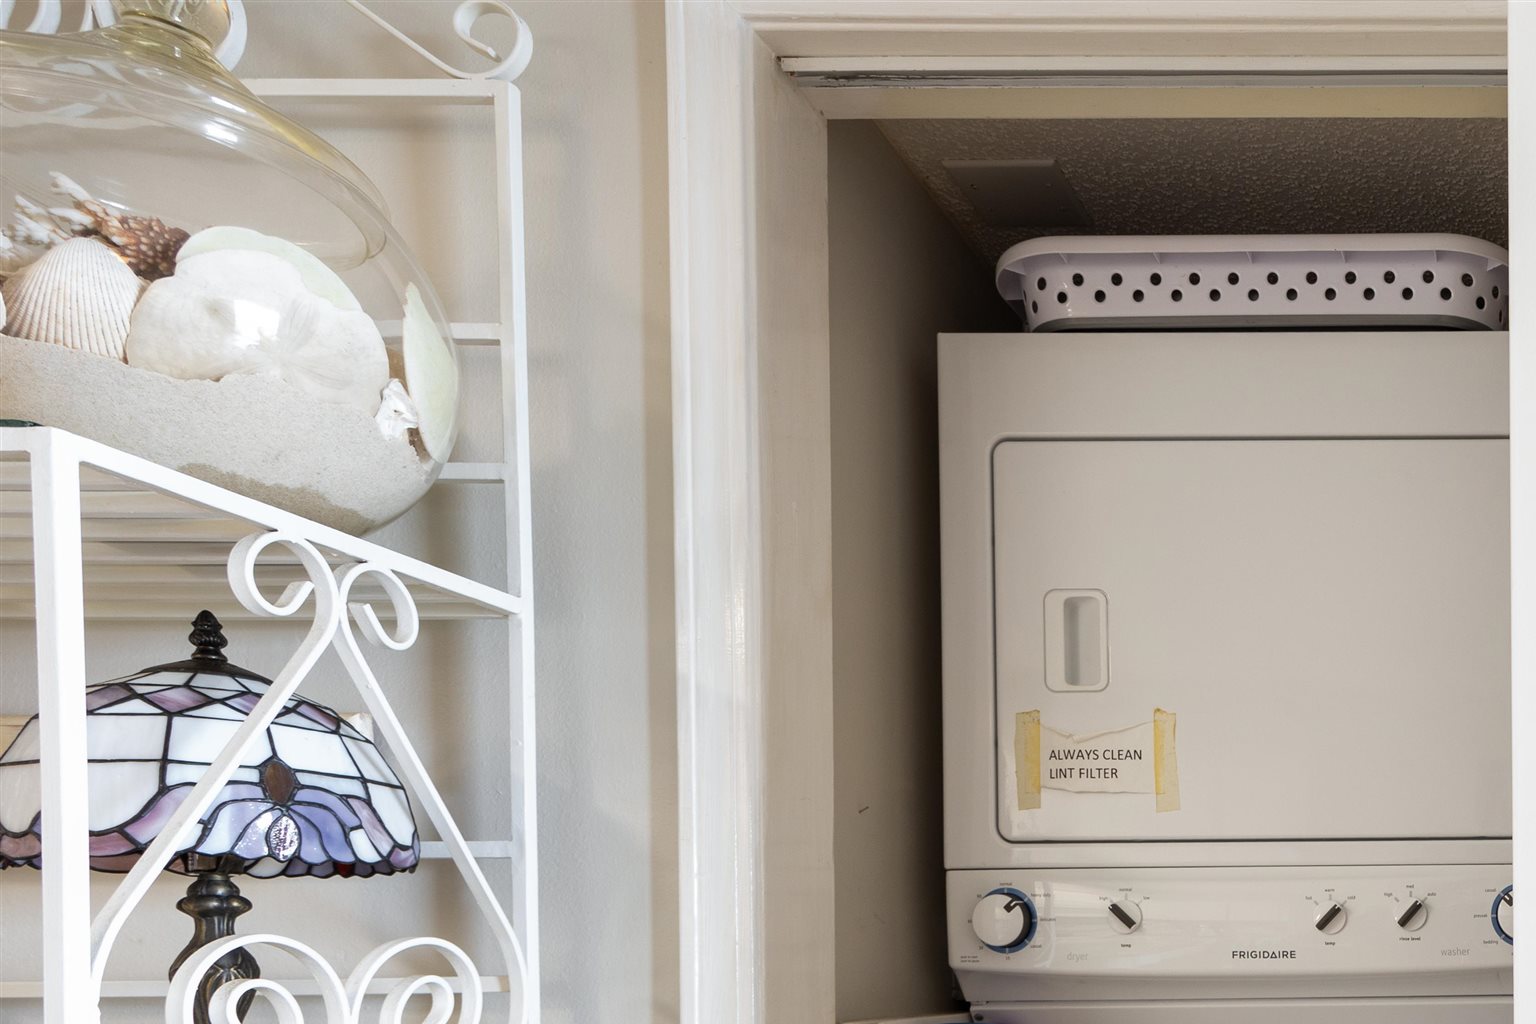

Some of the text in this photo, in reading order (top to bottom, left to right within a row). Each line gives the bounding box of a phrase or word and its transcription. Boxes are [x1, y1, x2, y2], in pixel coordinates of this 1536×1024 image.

[1049, 749, 1143, 761] ALWAYS CLEAN
[1049, 768, 1118, 780] LINT FILTER
[1066, 951, 1089, 963] dryer
[1231, 950, 1297, 959] FRIGIDAIRE
[1440, 946, 1471, 957] washer
